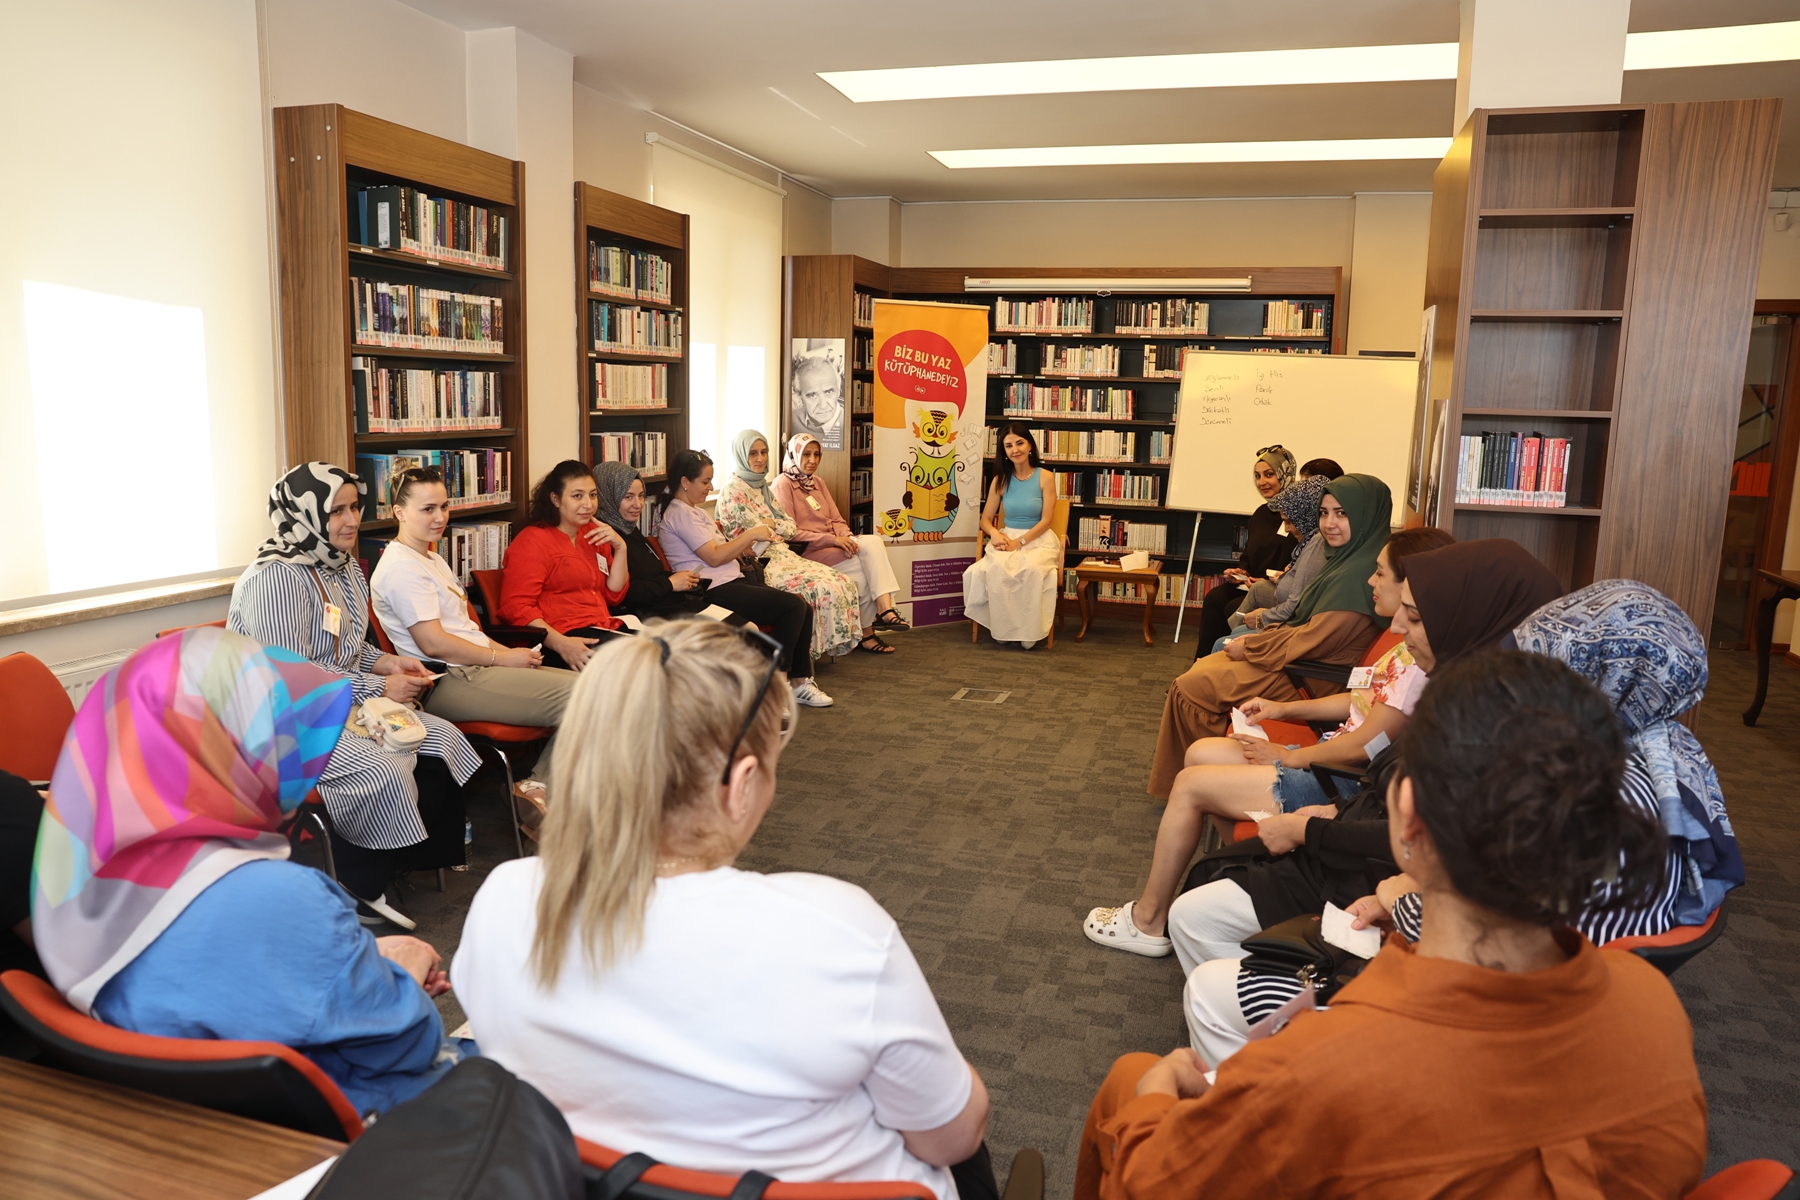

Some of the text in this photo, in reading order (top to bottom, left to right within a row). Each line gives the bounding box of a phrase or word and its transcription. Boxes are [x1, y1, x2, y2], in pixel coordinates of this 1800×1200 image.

[894, 344, 952, 370] BİZ BU YAZ
